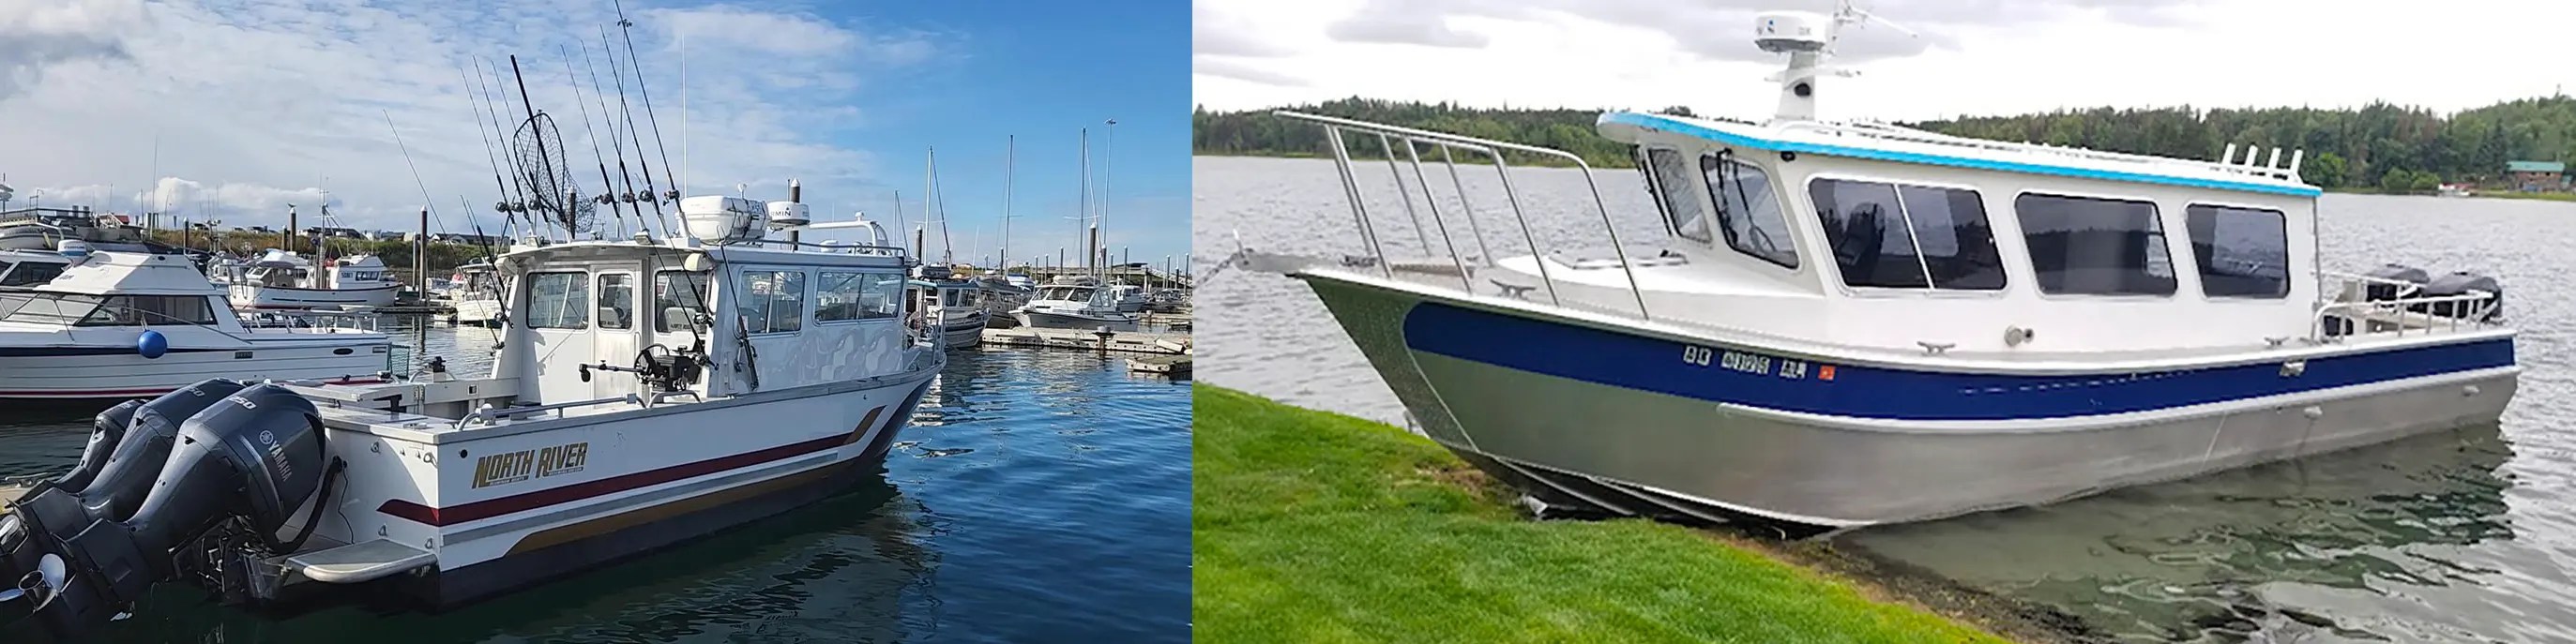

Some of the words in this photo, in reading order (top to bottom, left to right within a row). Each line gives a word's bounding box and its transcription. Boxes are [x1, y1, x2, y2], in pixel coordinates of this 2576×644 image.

[228, 396, 257, 410] 250
[268, 440, 293, 482] YAMAHA
[471, 449, 536, 489] NORTH
[535, 442, 589, 479] RIVER
